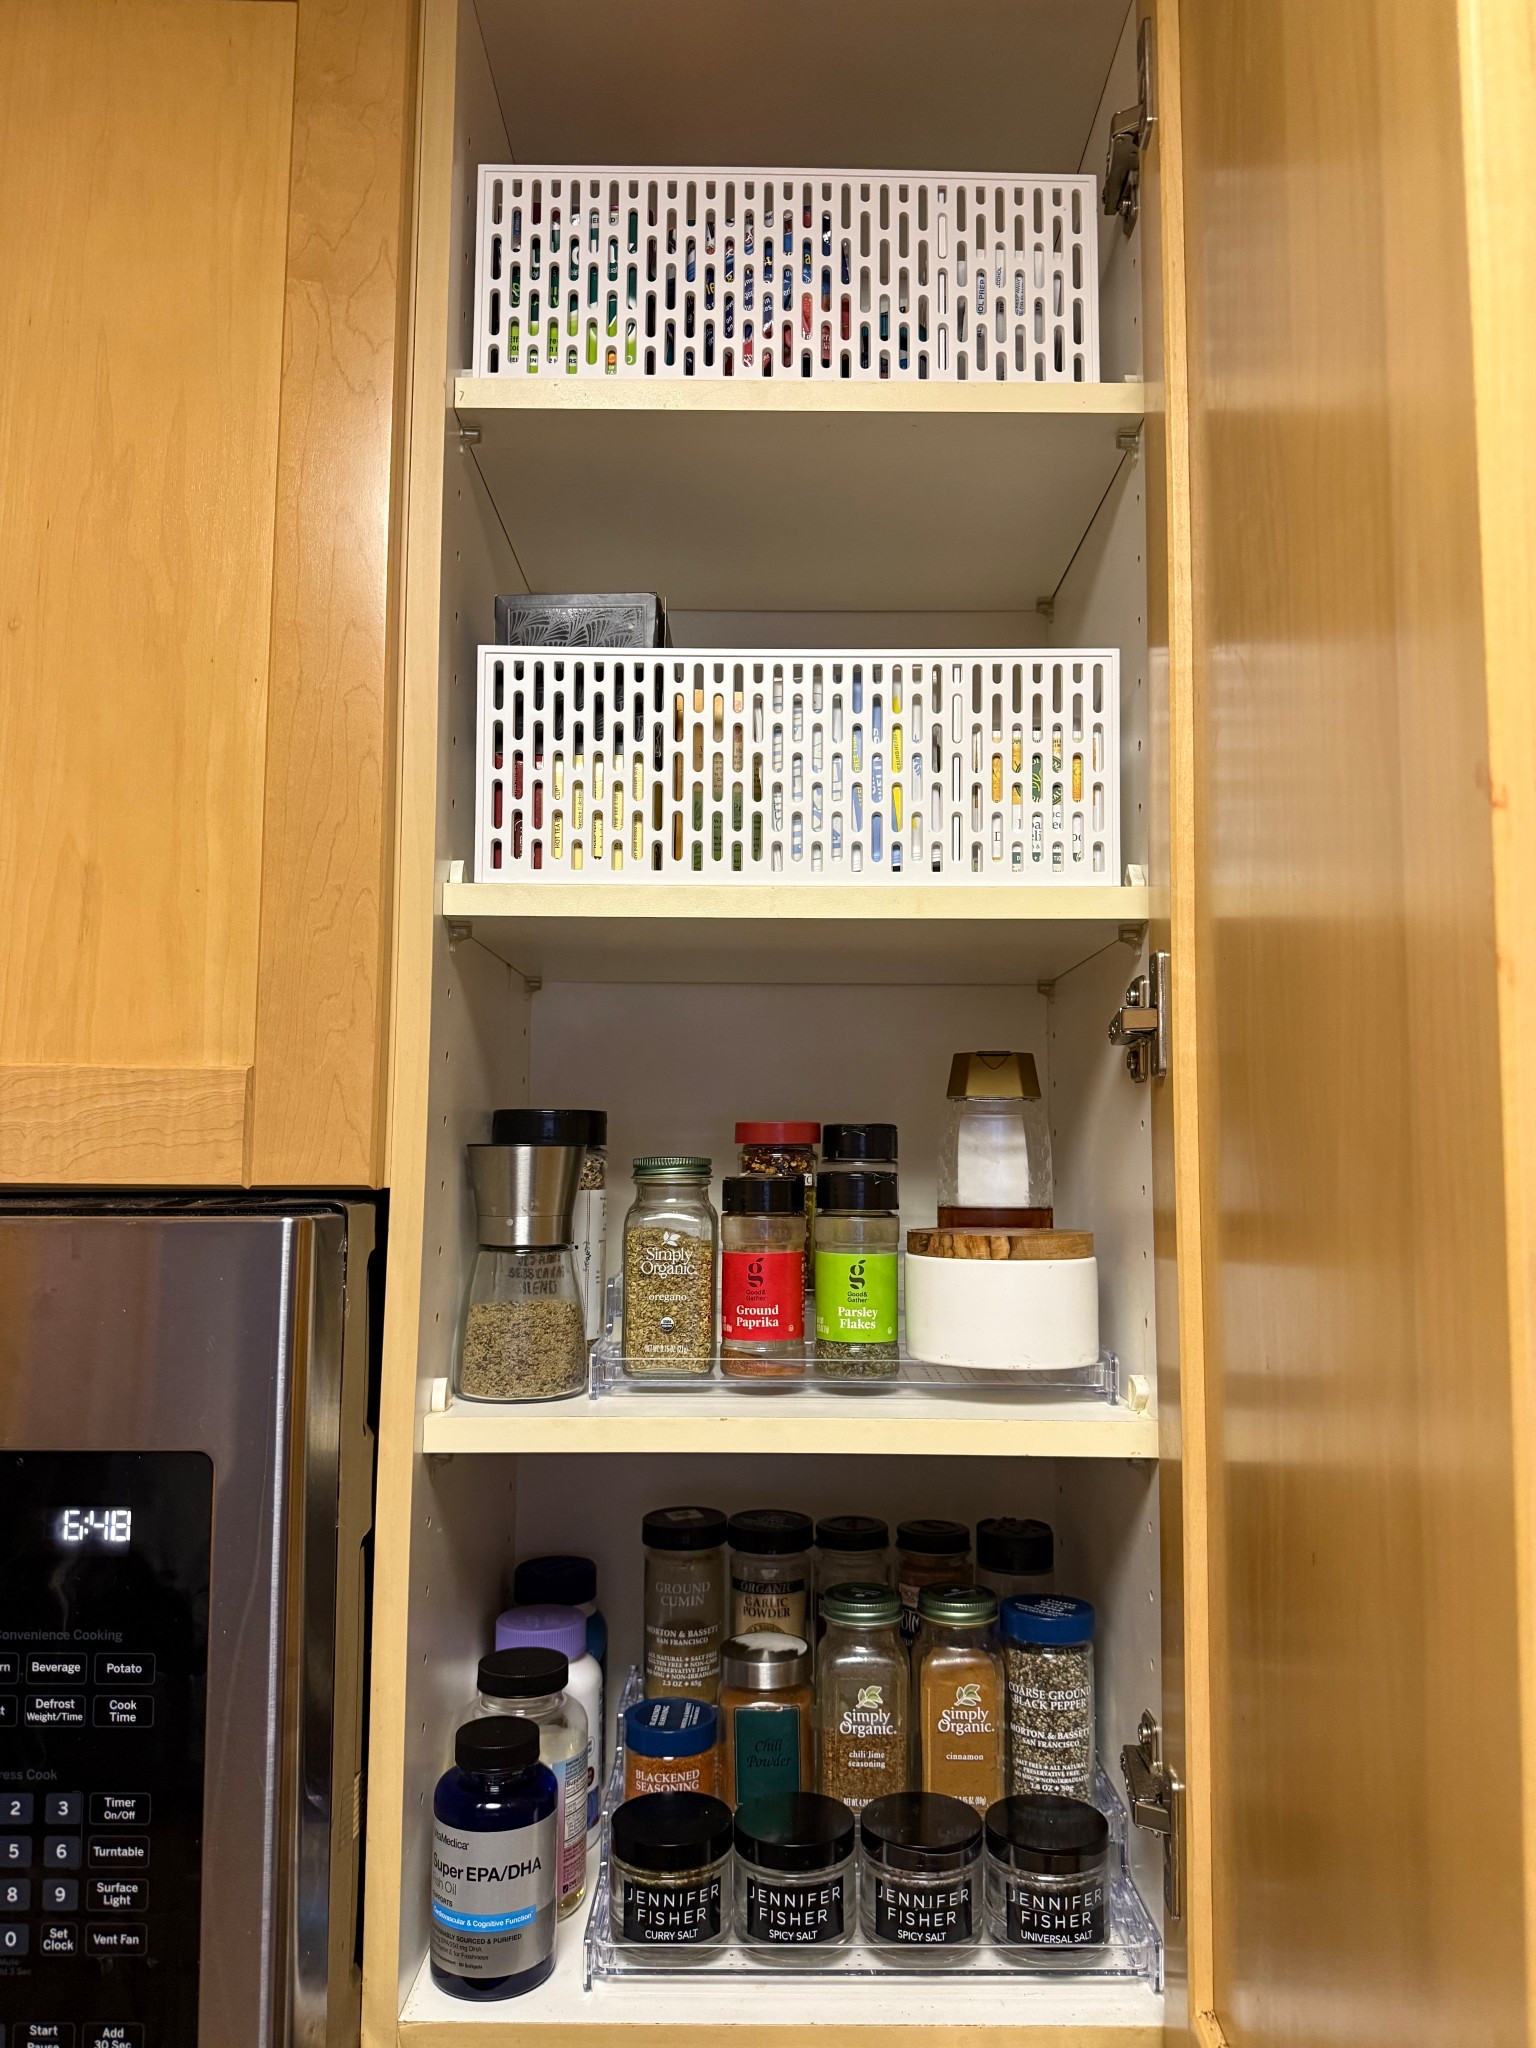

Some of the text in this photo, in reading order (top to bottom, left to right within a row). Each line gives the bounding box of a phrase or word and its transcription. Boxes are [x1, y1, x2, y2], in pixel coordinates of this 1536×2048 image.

[646, 1247, 693, 1265] Simply
[648, 1293, 687, 1302] oregano
[736, 1304, 779, 1315] Ground
[837, 1306, 878, 1318] Parsley
[736, 1316, 779, 1330] Paprika
[839, 1318, 876, 1329] Flakes
[63, 1510, 131, 1541] 6:48
[655, 1581, 711, 1595] GROUND
[740, 1581, 793, 1594] ORGANIC
[660, 1595, 704, 1607] CUMIN
[745, 1596, 788, 1607] GARLIC
[743, 1606, 791, 1618] POWDER
[73, 1628, 123, 1643] Cooking
[679, 1630, 686, 1638] &
[656, 1637, 709, 1646] SAN FRANCISCO
[31, 1662, 81, 1675] Beverage
[106, 1663, 142, 1674] Potato
[1008, 1681, 1091, 1701] COARSE GROUND
[35, 1699, 75, 1710] Defrost
[109, 1699, 137, 1710] Cook
[1014, 1694, 1087, 1711] BLACK PEPPER
[26, 1711, 83, 1723] Weight/Time
[109, 1711, 137, 1722] Time
[843, 1709, 891, 1727] Simply
[941, 1707, 989, 1725] Simply
[1010, 1722, 1045, 1738] MORTON
[1047, 1732, 1056, 1740] &
[754, 1738, 783, 1752] Chili
[1021, 1737, 1080, 1749] SAN FRANCISCO
[746, 1753, 792, 1769] Powder
[848, 1750, 885, 1759] chili lime
[945, 1752, 984, 1761] cinnamon
[848, 1760, 886, 1769] seasoning
[26, 1768, 58, 1781] Cook
[635, 1769, 700, 1784] BLACKENED
[635, 1780, 699, 1793] SEASONING
[1042, 1784, 1053, 1792] OZ
[10, 1801, 21, 1816] 2
[57, 1801, 69, 1816] 3
[104, 1797, 136, 1807] Timer
[103, 1810, 136, 1820] On/Off
[8, 1844, 19, 1859] 5
[55, 1844, 67, 1859] 6
[93, 1846, 144, 1857] Turntable
[433, 1852, 464, 1880] Super
[466, 1856, 542, 1882] EPA/DHA
[96, 1882, 138, 1893] Surface
[444, 1880, 457, 1895] Oil
[6, 1887, 18, 1902] 8
[54, 1887, 66, 1902] 9
[103, 1894, 131, 1906] Light
[627, 1884, 719, 1908] JENNIFER
[750, 1886, 841, 1908] JENNIFER
[878, 1885, 969, 1909] JENNIFER
[1010, 1888, 1102, 1911] JENNIFER
[637, 1907, 707, 1926] FISHER
[759, 1907, 828, 1926] FISHER
[887, 1907, 956, 1927] FISHER
[1021, 1910, 1092, 1929] FISHER
[466, 1919, 472, 1927] &
[473, 1920, 504, 1928] Cognitive
[5, 1931, 16, 1947] 0
[49, 1928, 68, 1939] Set
[93, 1934, 139, 1945] Vent Fan
[456, 1936, 485, 1944] SOURCED
[493, 1934, 522, 1943] PURIFIED
[645, 1929, 699, 1940] CURRY SALT
[769, 1929, 818, 1941] SPICY SALT
[897, 1929, 947, 1942] SPICY SALT
[1020, 1929, 1093, 1944] UNIVERSAL SALT
[43, 1939, 74, 1950] Clock
[29, 2025, 58, 2036] Start
[102, 2027, 125, 2038] Add
[94, 2040, 131, 2048] 30 Sec
